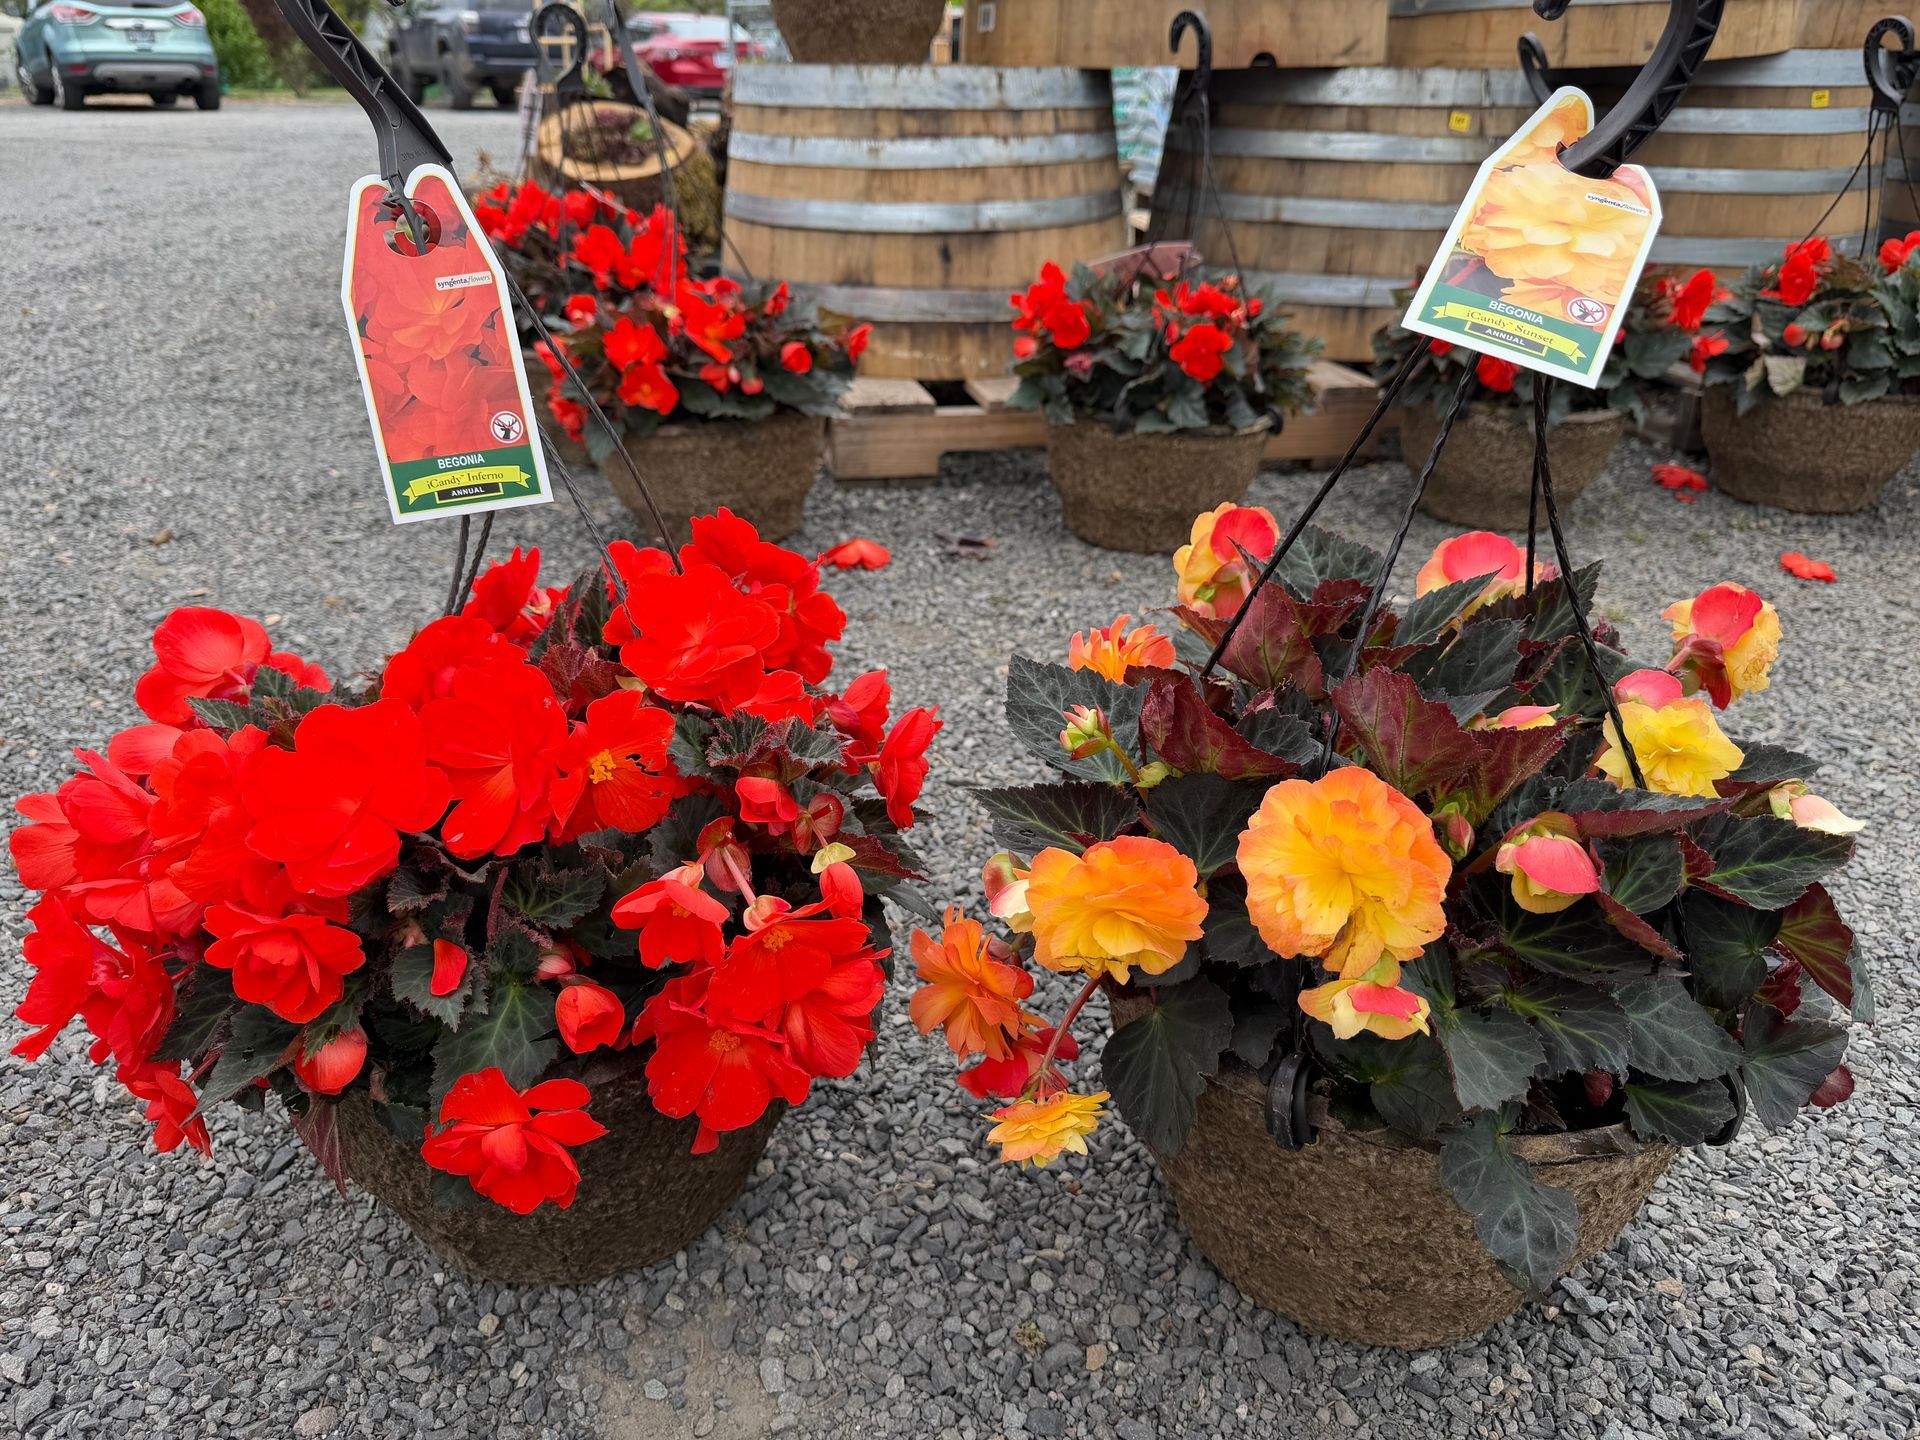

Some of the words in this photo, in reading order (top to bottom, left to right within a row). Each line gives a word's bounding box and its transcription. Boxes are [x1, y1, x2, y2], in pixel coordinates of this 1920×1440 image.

[1488, 300, 1544, 325] BEGONIA
[1485, 328, 1526, 346] ANNUAL
[1514, 324, 1555, 345] Sunset
[437, 453, 486, 469] BEGONIA
[467, 472, 504, 482] Inferno
[451, 486, 485, 497] ANNUAL
